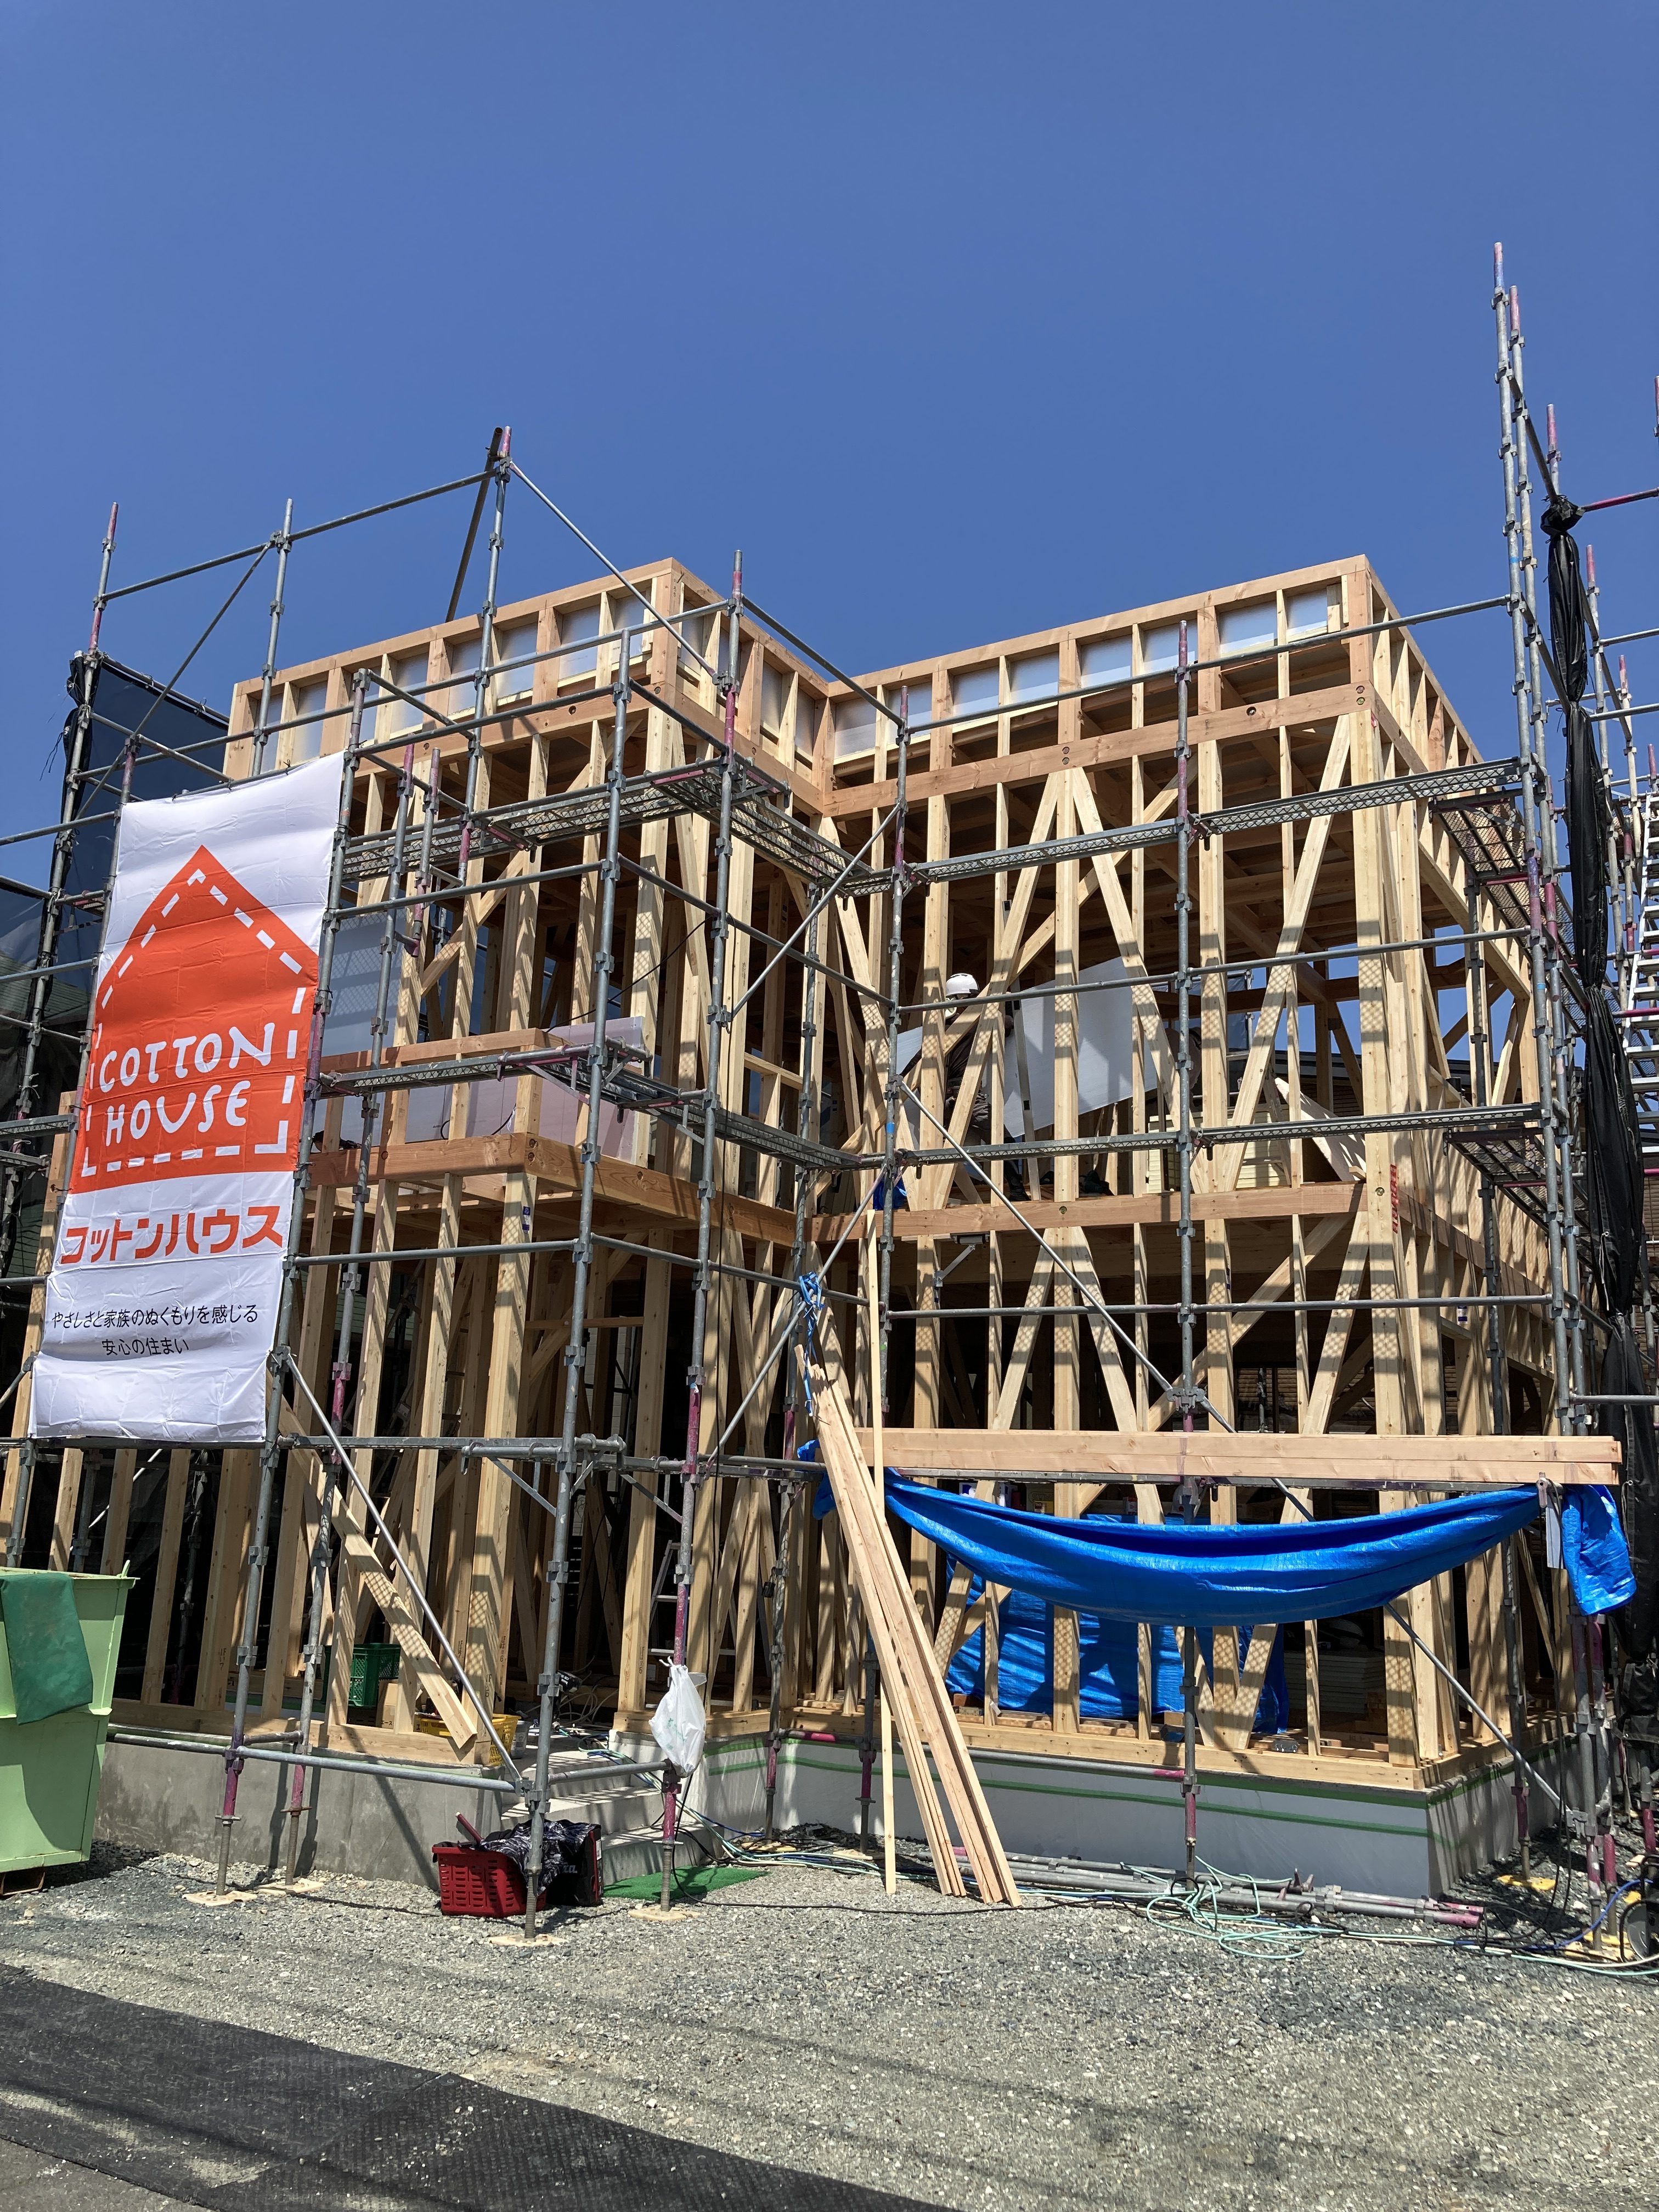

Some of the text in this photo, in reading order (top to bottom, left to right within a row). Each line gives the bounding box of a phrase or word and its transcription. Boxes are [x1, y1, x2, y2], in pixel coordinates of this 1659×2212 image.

[100, 1023, 275, 1092] COTTON
[106, 1081, 250, 1146] HOUSE
[61, 1206, 282, 1263] コットンハウス
[52, 1305, 257, 1328] やさしさと家族のぬくもりを感じる
[101, 1338, 189, 1356] 安心の住まい
